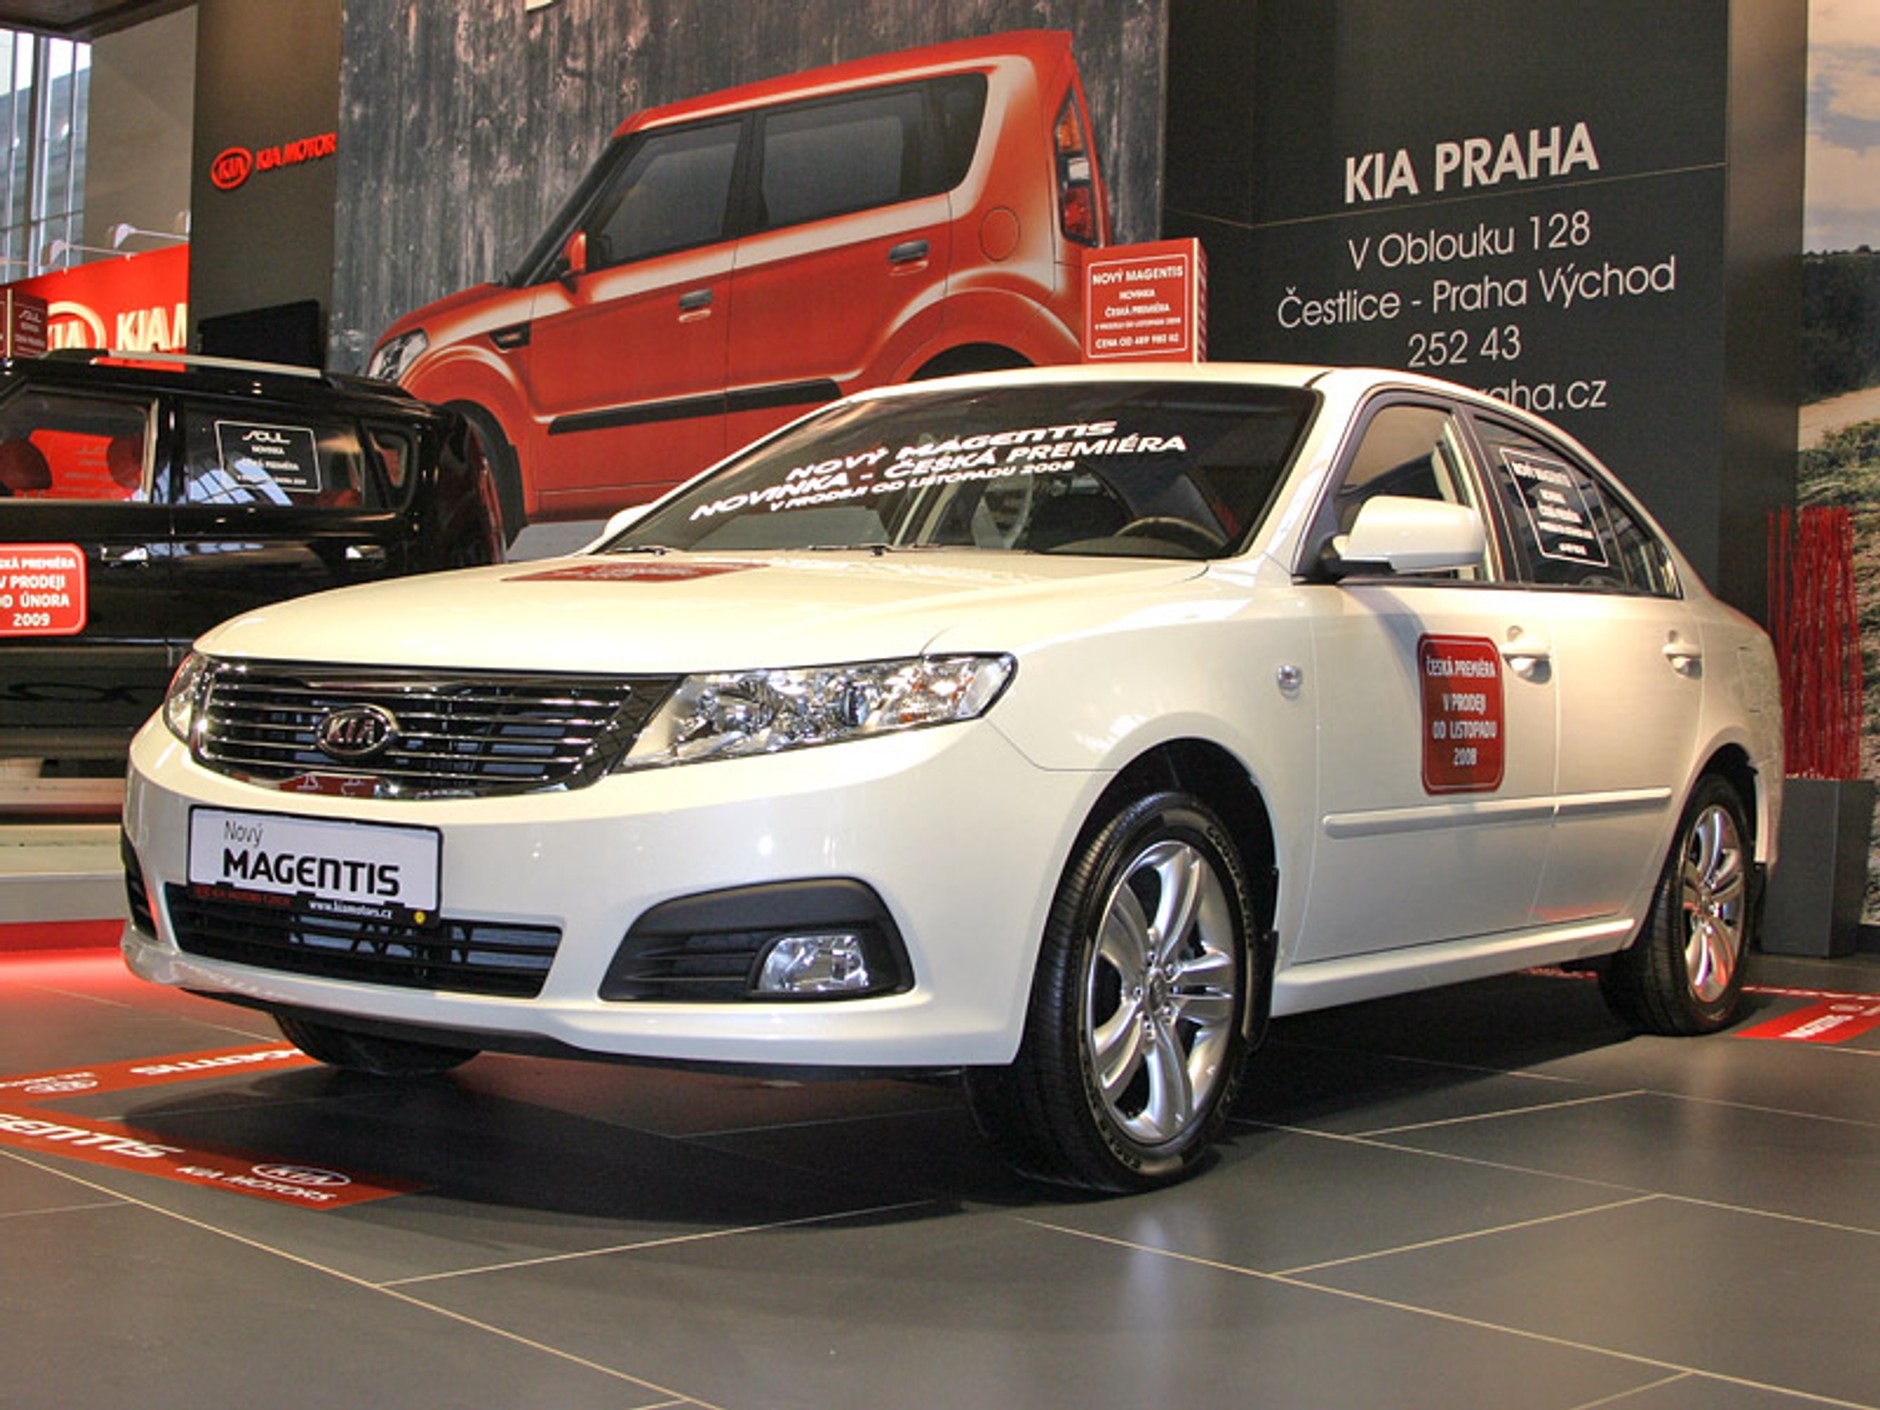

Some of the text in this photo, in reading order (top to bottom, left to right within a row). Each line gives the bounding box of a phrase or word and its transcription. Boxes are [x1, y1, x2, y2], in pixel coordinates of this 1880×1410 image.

[256, 145, 284, 171] KIA
[1345, 121, 1600, 204] KIA PRAHA
[1348, 209, 1591, 271] V Oblouku 128
[1092, 265, 1184, 285] NOVÝ MAGENTIS
[1277, 286, 1400, 329] Čestlice
[1432, 275, 1527, 314] Praha
[1538, 254, 1677, 309] Východ
[116, 307, 171, 351] KIA
[1407, 325, 1522, 368] 252 43
[785, 420, 1117, 482] NOVÝ MAGENTIS
[689, 471, 849, 521] NOVINKA
[884, 446, 997, 479] ČESKÁ
[1006, 433, 1187, 463] PREMIÉRA
[871, 480, 906, 494] OD
[1020, 460, 1076, 476] 2008
[21, 556, 77, 570] PREMIÉRA
[9, 574, 66, 592] PRODEJI
[20, 590, 71, 608] ÚNORA
[13, 612, 51, 627] 2009
[326, 717, 377, 744] KIA
[1450, 719, 1498, 739] LISTOPADU
[1453, 747, 1478, 767] 2008
[224, 819, 265, 848] Nový
[223, 848, 400, 897] MAGENTIS
